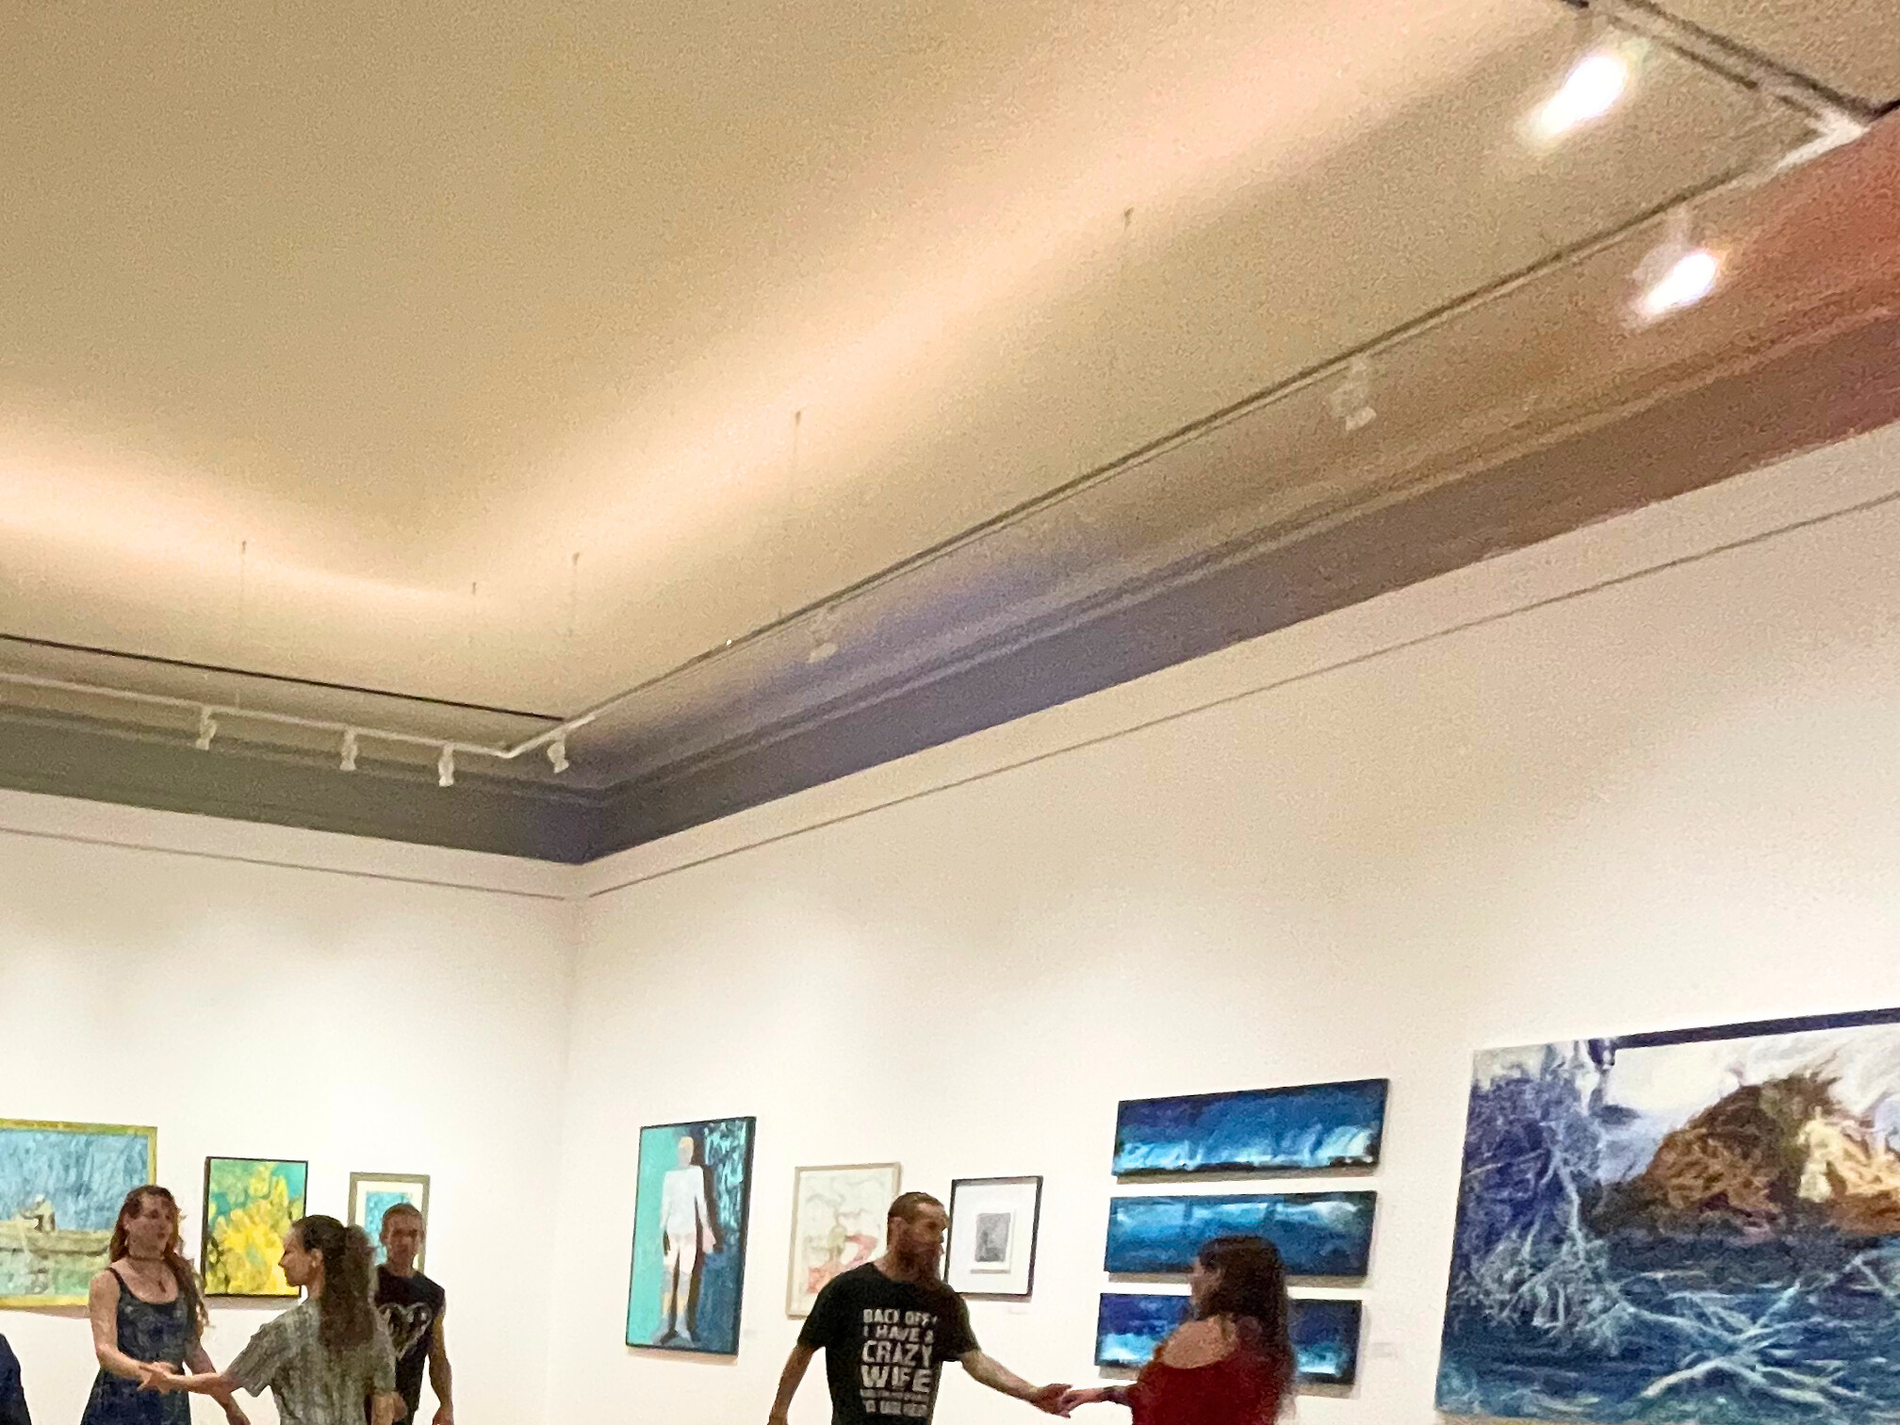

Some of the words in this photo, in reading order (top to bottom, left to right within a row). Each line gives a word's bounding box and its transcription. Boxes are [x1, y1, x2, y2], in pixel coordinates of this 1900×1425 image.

[875, 1324, 921, 1343] HAVE
[861, 1340, 933, 1368] CRAZY
[861, 1365, 933, 1393] WIFE
